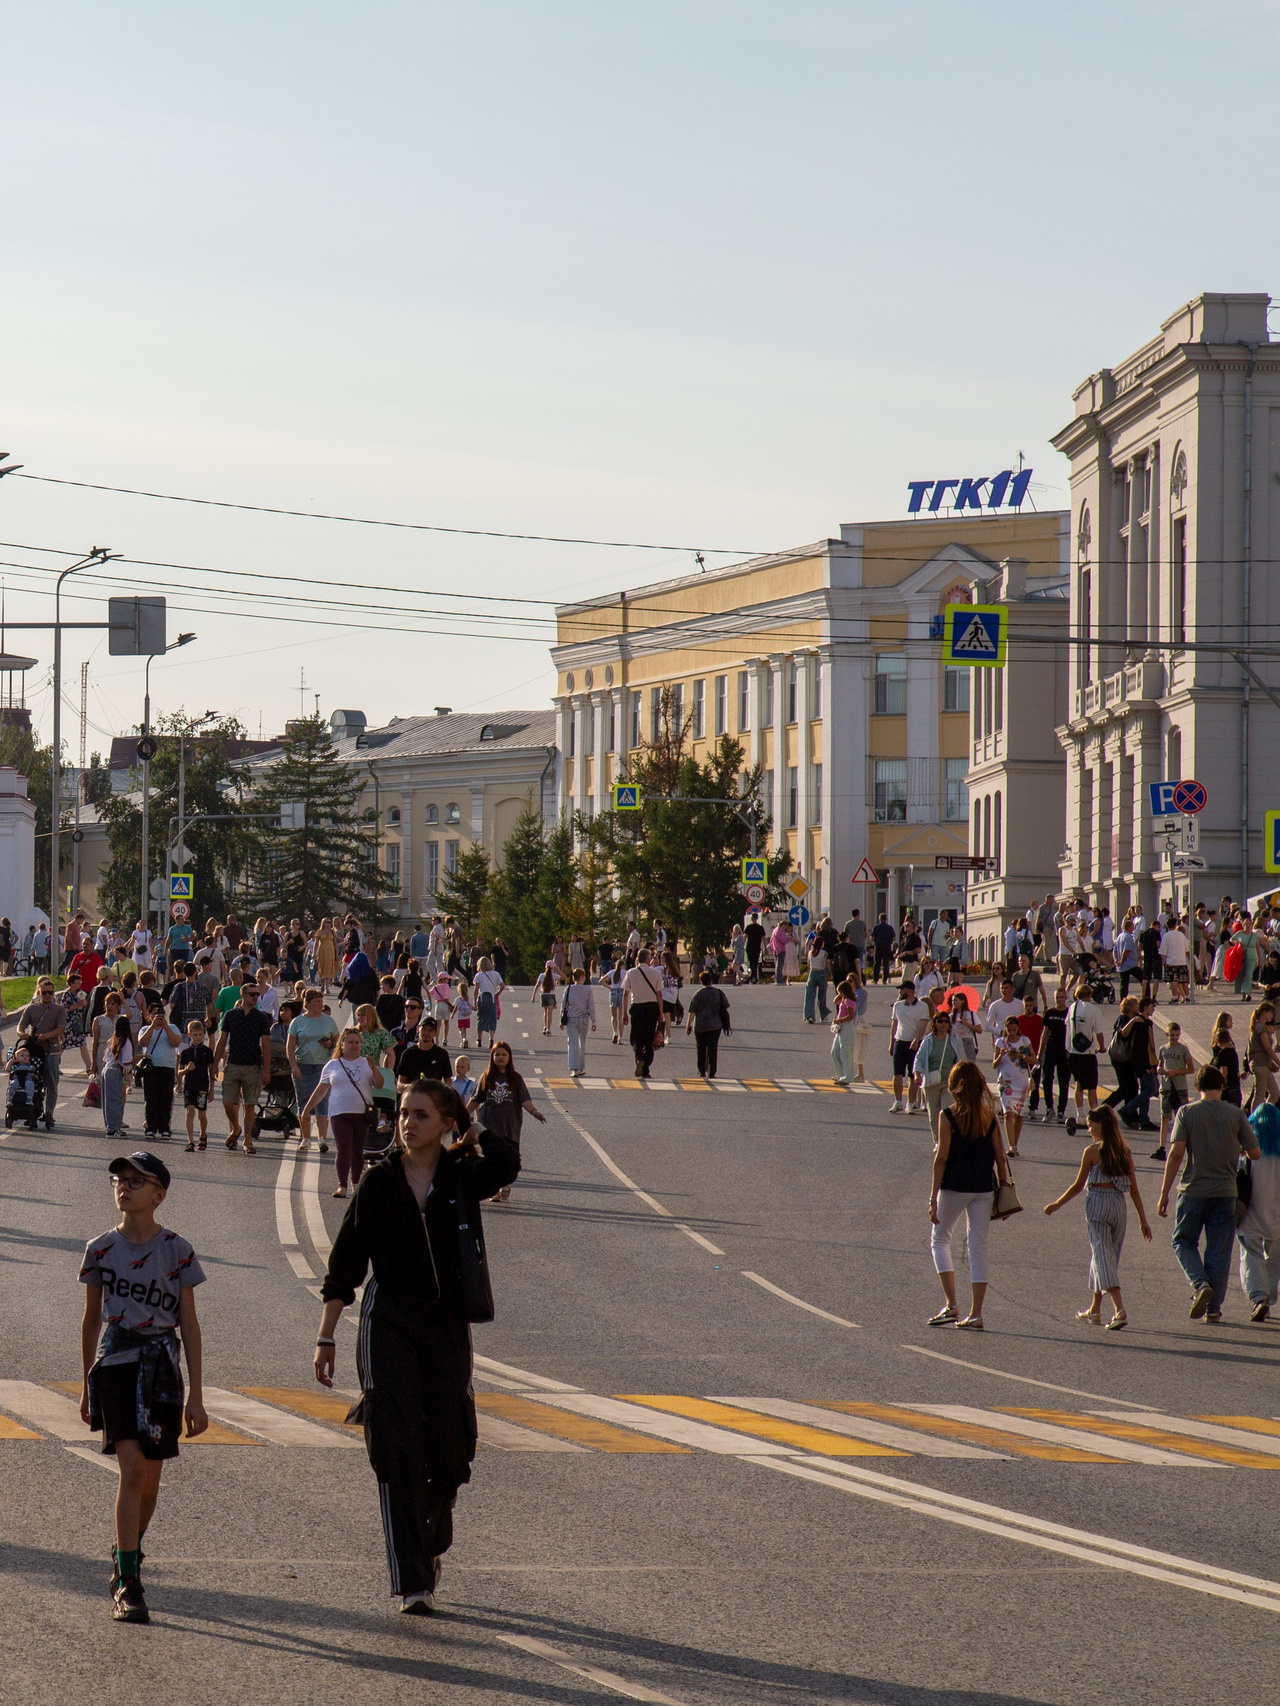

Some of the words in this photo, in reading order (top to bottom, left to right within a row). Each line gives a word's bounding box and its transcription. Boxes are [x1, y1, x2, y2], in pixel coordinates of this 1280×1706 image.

[907, 469, 1033, 512] ТГК11
[1159, 785, 1176, 812] P
[1186, 835, 1196, 843] 10
[750, 890, 761, 899] 40
[174, 906, 186, 914] 40
